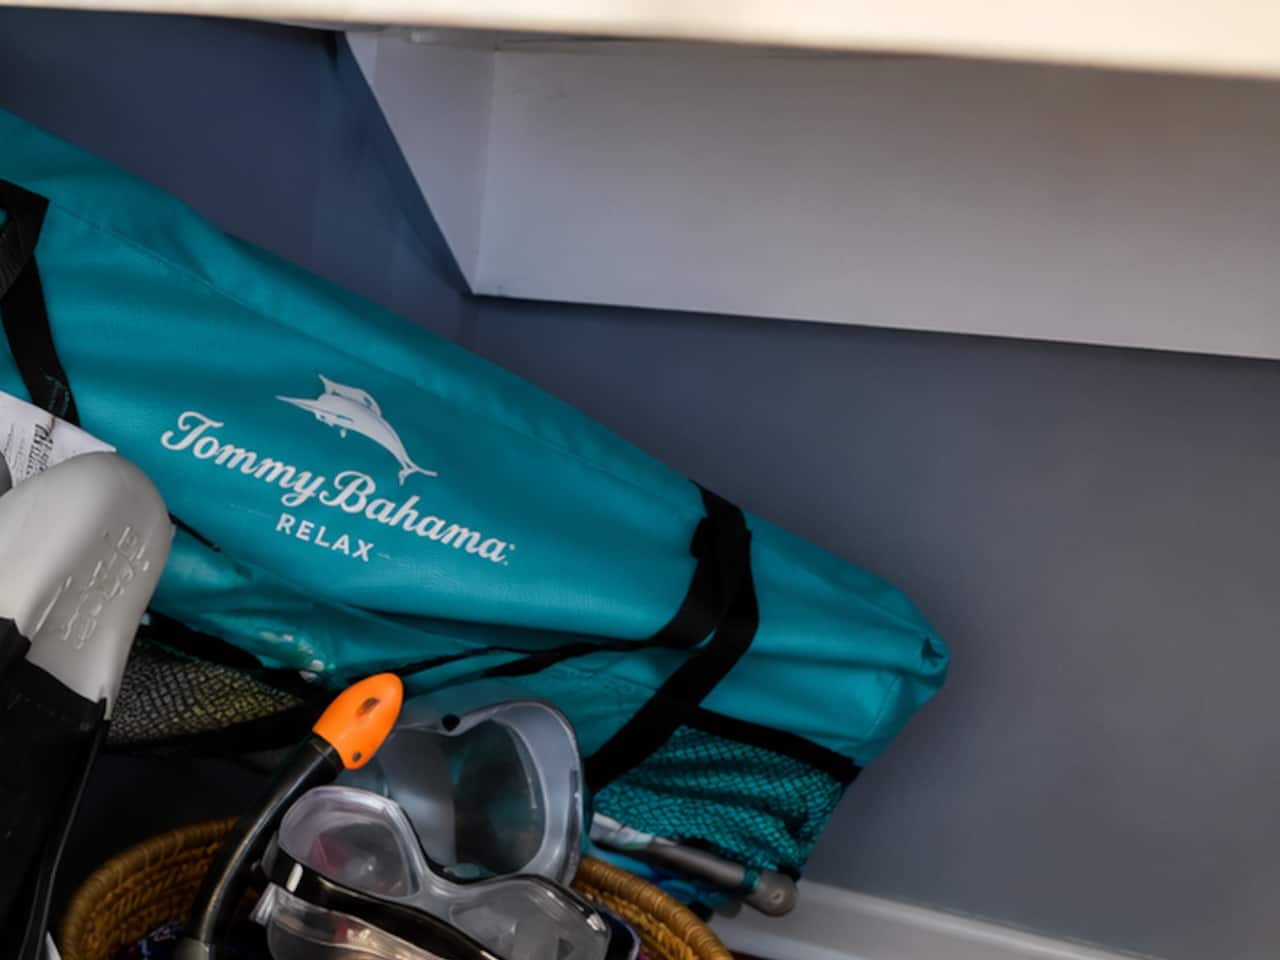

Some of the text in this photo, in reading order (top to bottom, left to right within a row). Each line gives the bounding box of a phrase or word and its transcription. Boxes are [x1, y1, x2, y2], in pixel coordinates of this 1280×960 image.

[160, 410, 325, 507] Tommy
[320, 470, 510, 564] Bahama
[275, 513, 375, 562] RELAX
